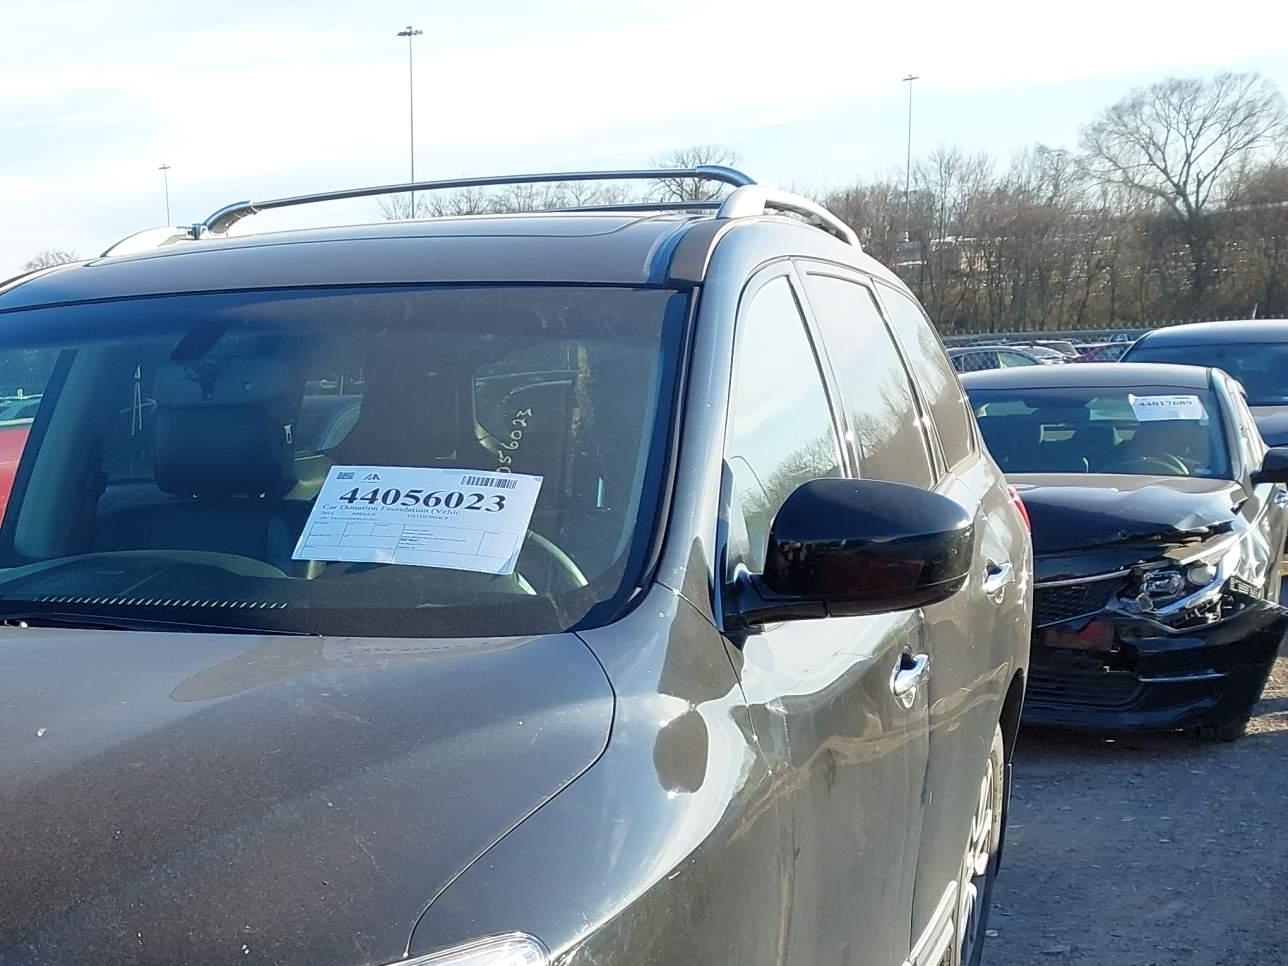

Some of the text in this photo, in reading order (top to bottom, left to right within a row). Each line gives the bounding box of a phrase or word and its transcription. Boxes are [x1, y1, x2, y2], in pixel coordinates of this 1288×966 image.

[339, 487, 506, 513] 44056023
[340, 504, 379, 512] Donation
[380, 505, 430, 514] Foundation
